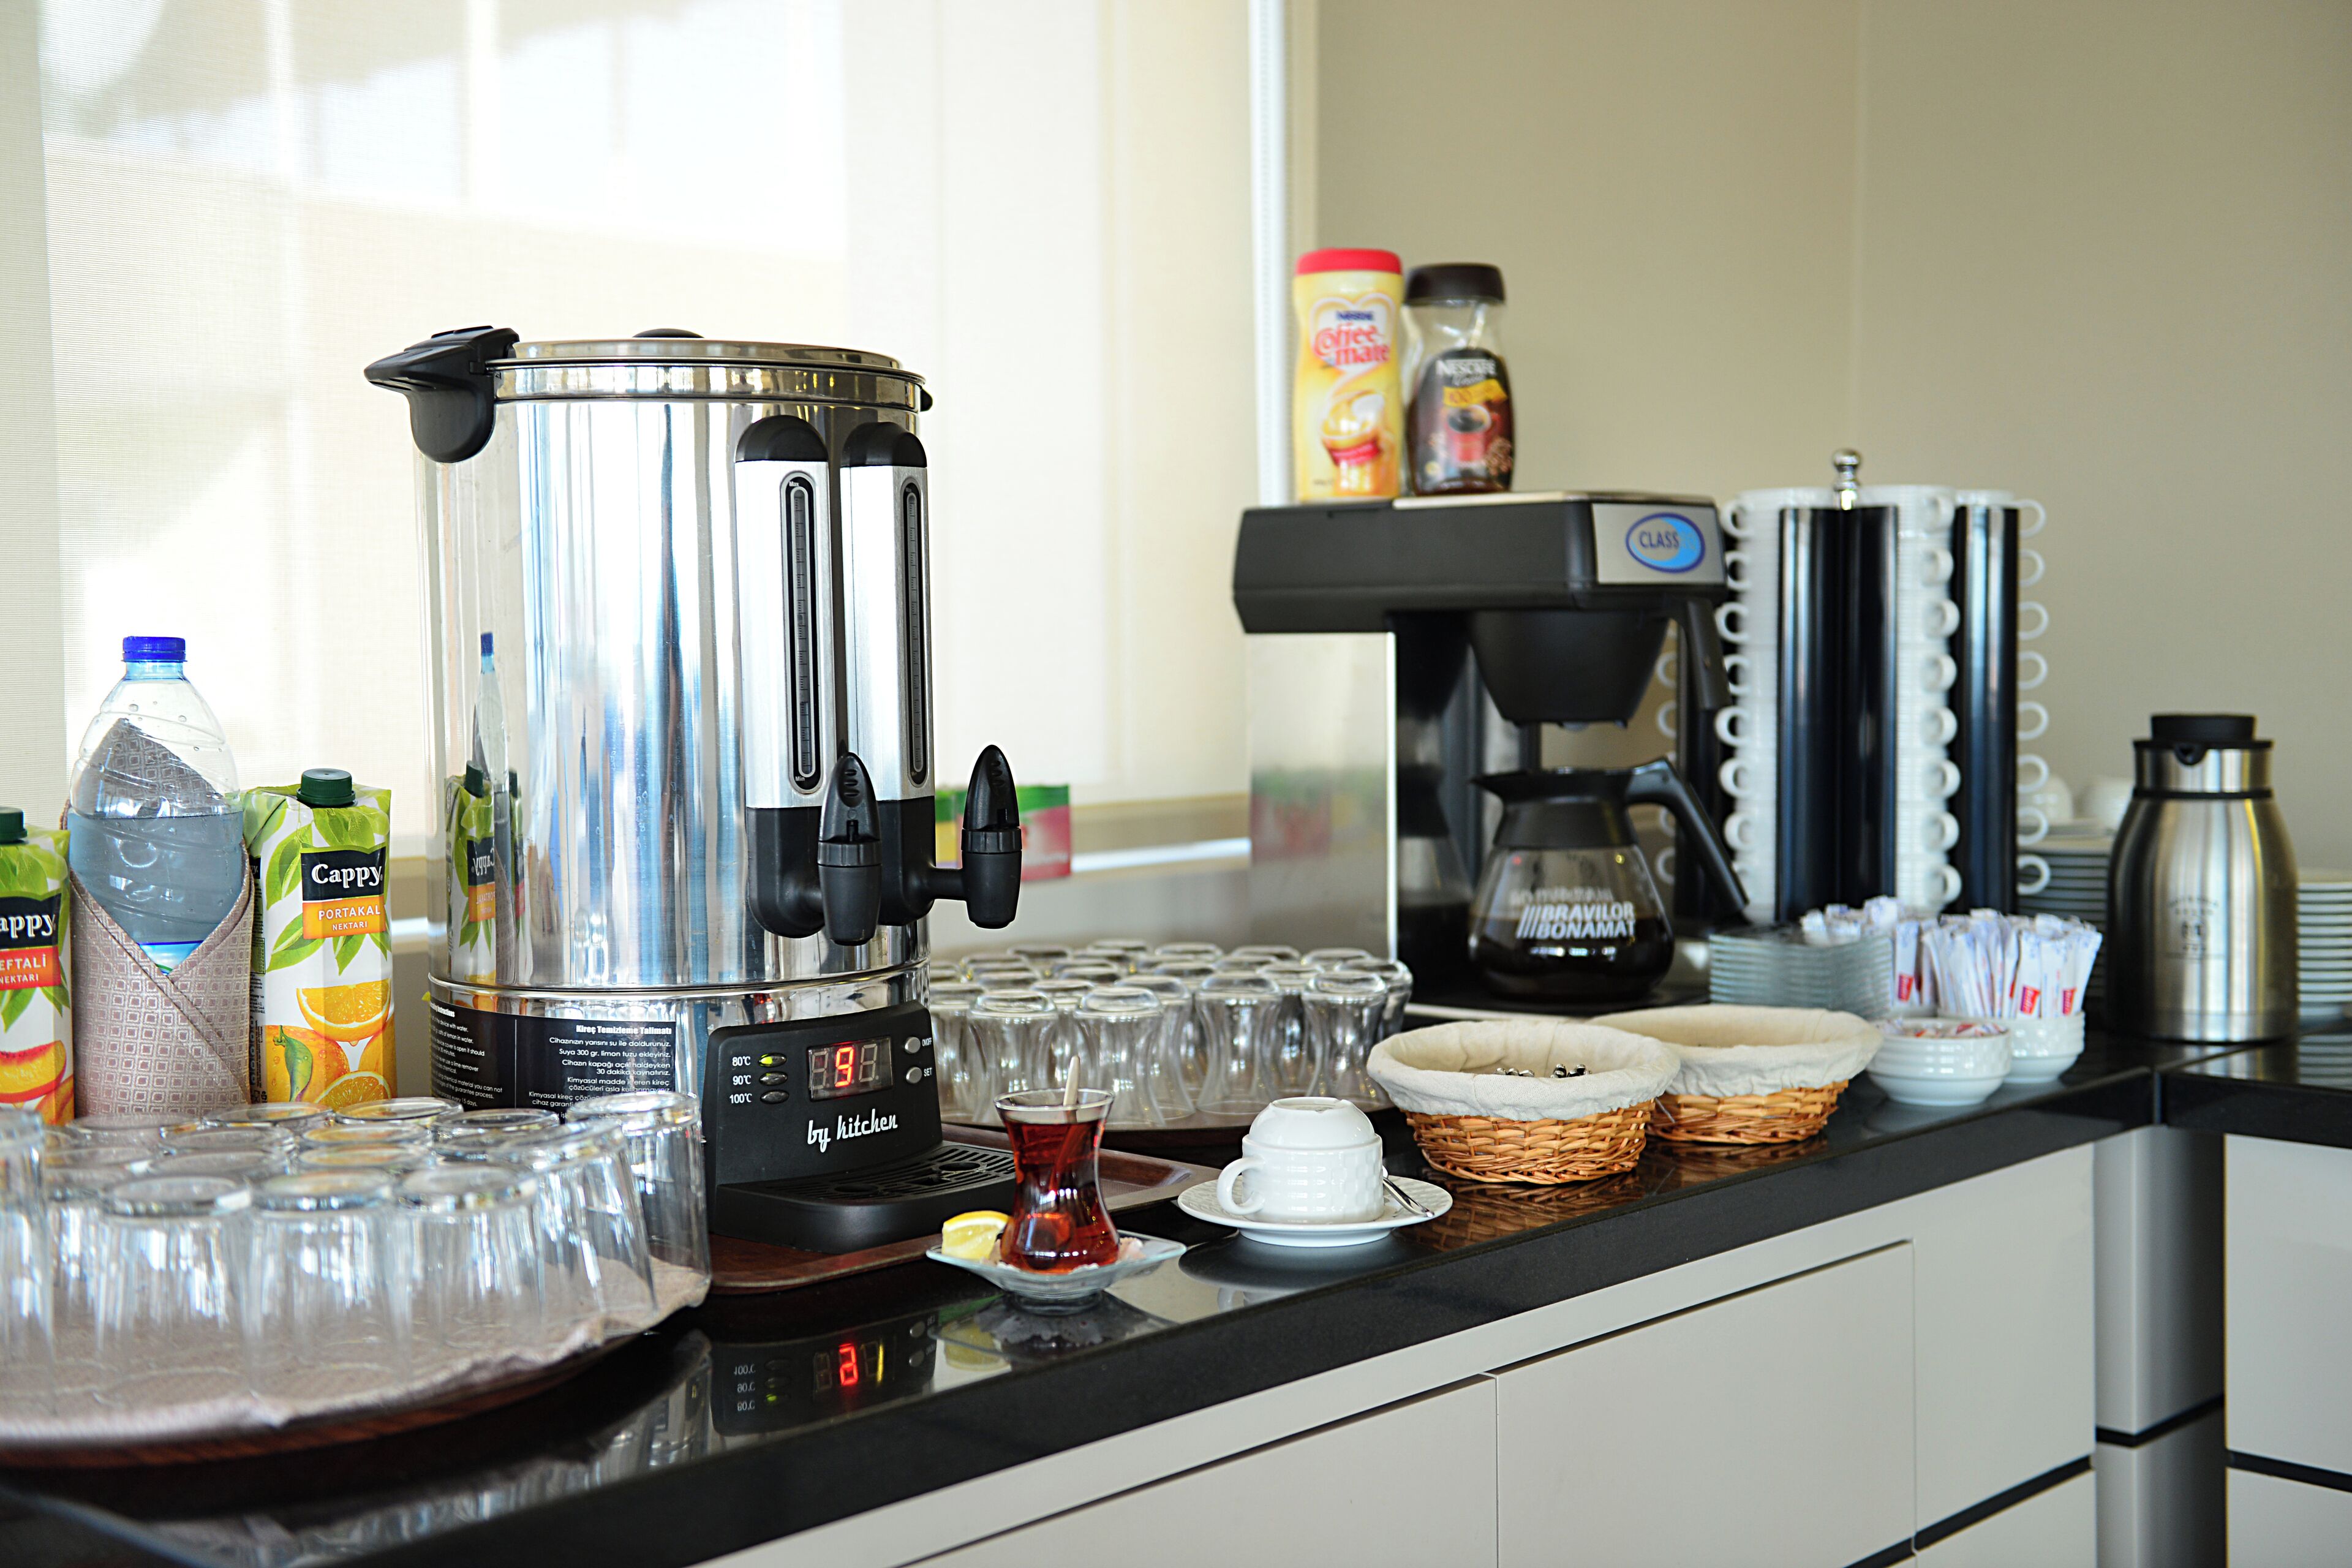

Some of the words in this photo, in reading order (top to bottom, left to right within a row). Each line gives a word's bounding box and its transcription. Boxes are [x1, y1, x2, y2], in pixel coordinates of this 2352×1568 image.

[311, 864, 382, 888] Cappy
[318, 905, 380, 921] PORTAKAL
[1542, 901, 1634, 921] BRAVILOR
[0, 914, 55, 938] appy
[333, 921, 368, 931] NEKTARI
[1536, 919, 1636, 940] BONAMAT
[0, 954, 46, 971] EFTALİ
[576, 1025, 596, 1034] Kireç
[597, 1026, 638, 1035] Temizleme
[470, 1048, 485, 1057] should
[461, 1063, 478, 1072] remover
[588, 1060, 614, 1069] kapağı
[834, 1046, 854, 1087] 9
[924, 1067, 932, 1077] SET
[454, 1086, 474, 1095] guarantee
[475, 1090, 494, 1099] process.
[529, 1091, 556, 1099] Kimyasal
[807, 1120, 831, 1153] by
[837, 1109, 899, 1140] kitchen
